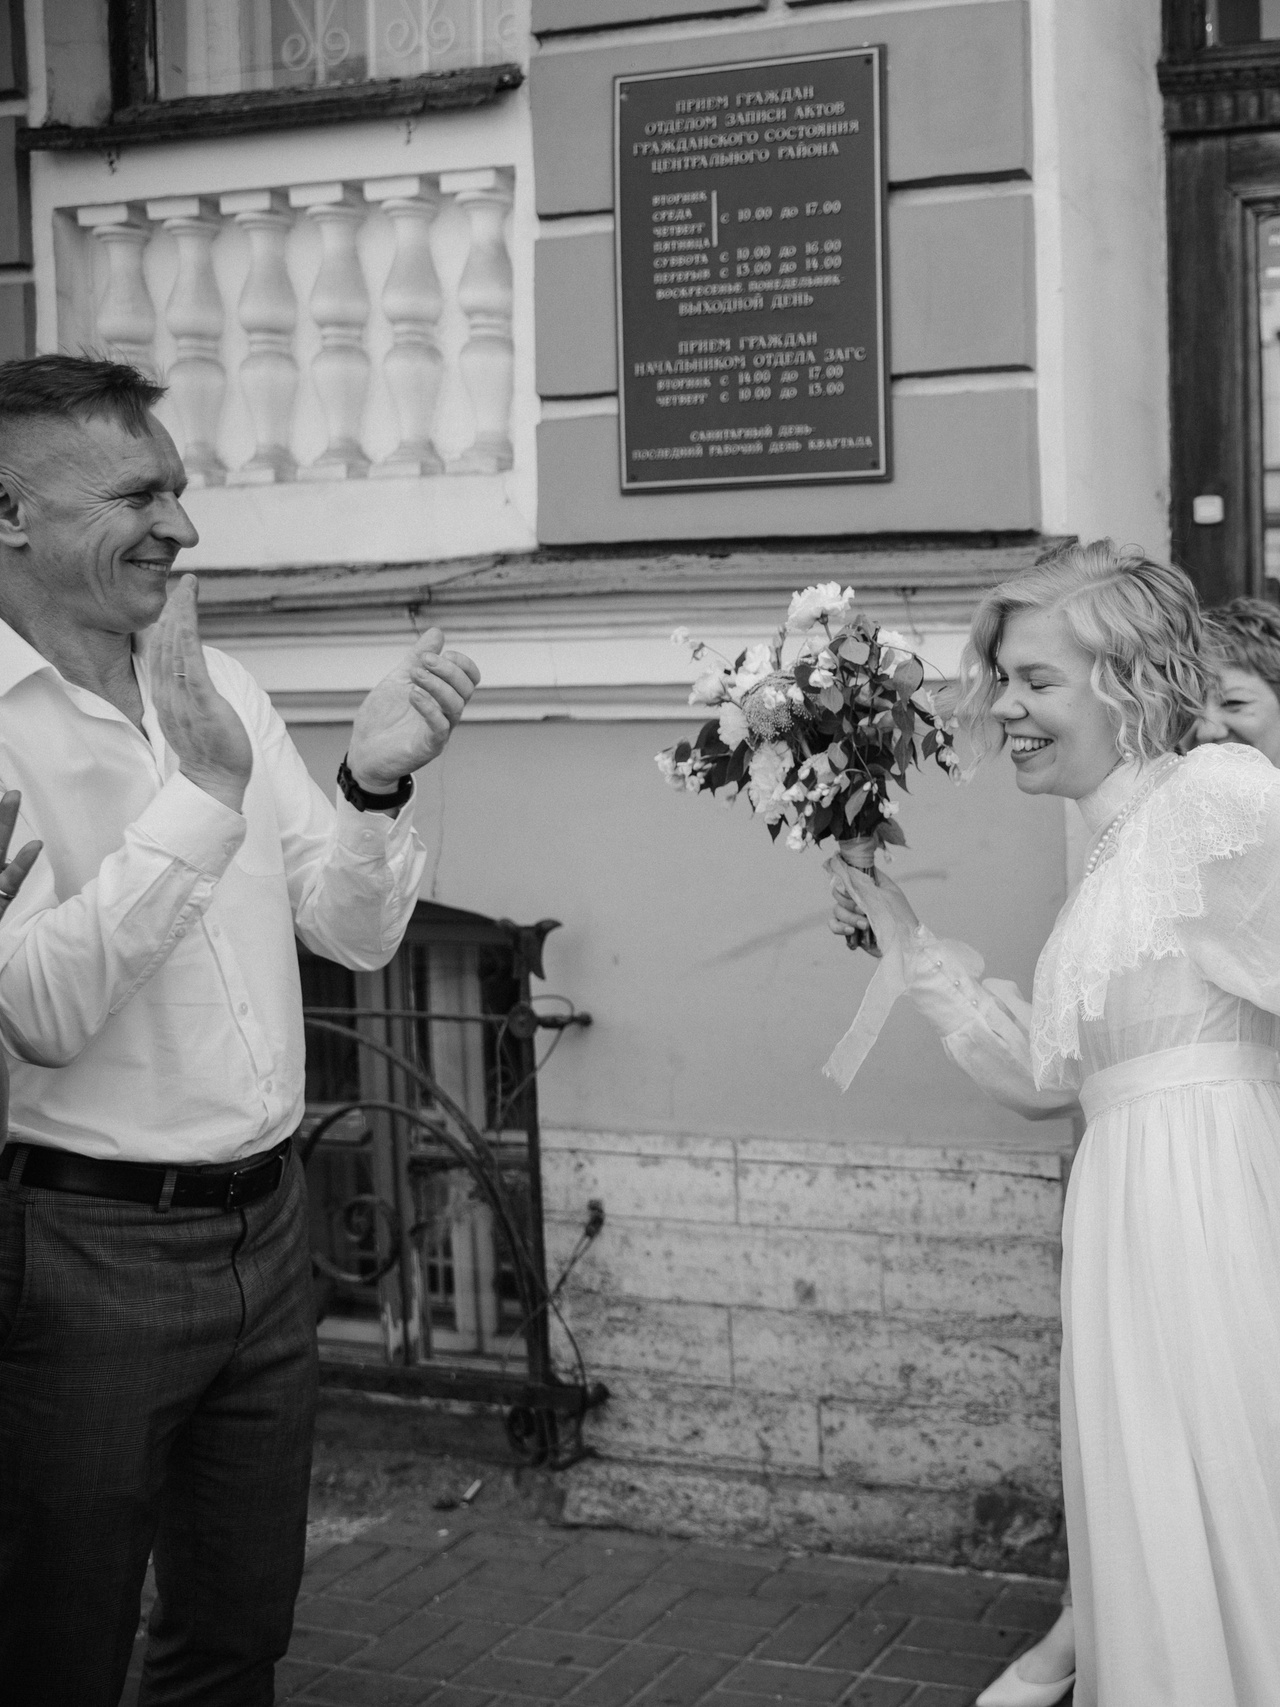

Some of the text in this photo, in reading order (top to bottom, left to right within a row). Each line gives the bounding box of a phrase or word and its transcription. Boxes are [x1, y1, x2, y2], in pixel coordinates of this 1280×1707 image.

[676, 86, 815, 114] ПРИЕМ ГРАЖДАН
[645, 101, 845, 135] ОТДЕЛОМ ЗАПИСИ АКТОВ
[633, 120, 859, 156] ГРАЖДАНСКОГО СОСТОЯНИЯ
[651, 141, 839, 174] ЦЕНТРАЛЬНОГО РАЙОНА
[652, 191, 707, 206] ВТОРНИК
[737, 206, 773, 222] 10.00
[805, 200, 841, 216] 17.00
[652, 209, 692, 223] СРЕДА
[652, 223, 705, 238] ЧЕТВЕРГ
[653, 238, 711, 253] ПЯТНИЦА
[653, 254, 708, 269] СУББОТА
[805, 240, 841, 255] 16.00
[736, 262, 771, 277] 13.00
[805, 255, 841, 271] 14.00
[679, 292, 813, 317] ВЫХОДНОЙ ДЕНЬ
[678, 332, 817, 355] ПРИЕМ ГРАЖДАН
[634, 347, 866, 377] НАЧАЛЬНИКОМ ОТДЕЛА ЗАГС
[657, 376, 711, 391] ВТОРНИК
[808, 365, 844, 381] 17.00
[656, 393, 708, 407] ЧЕТВЕРГ
[808, 381, 844, 397] 13.00
[690, 424, 773, 442] САНИТАРНЫЙ
[632, 436, 872, 461] ПОСЛЕДНИЙ РАБОЧИЙ ДЕНЬ КВАРТАЛА
